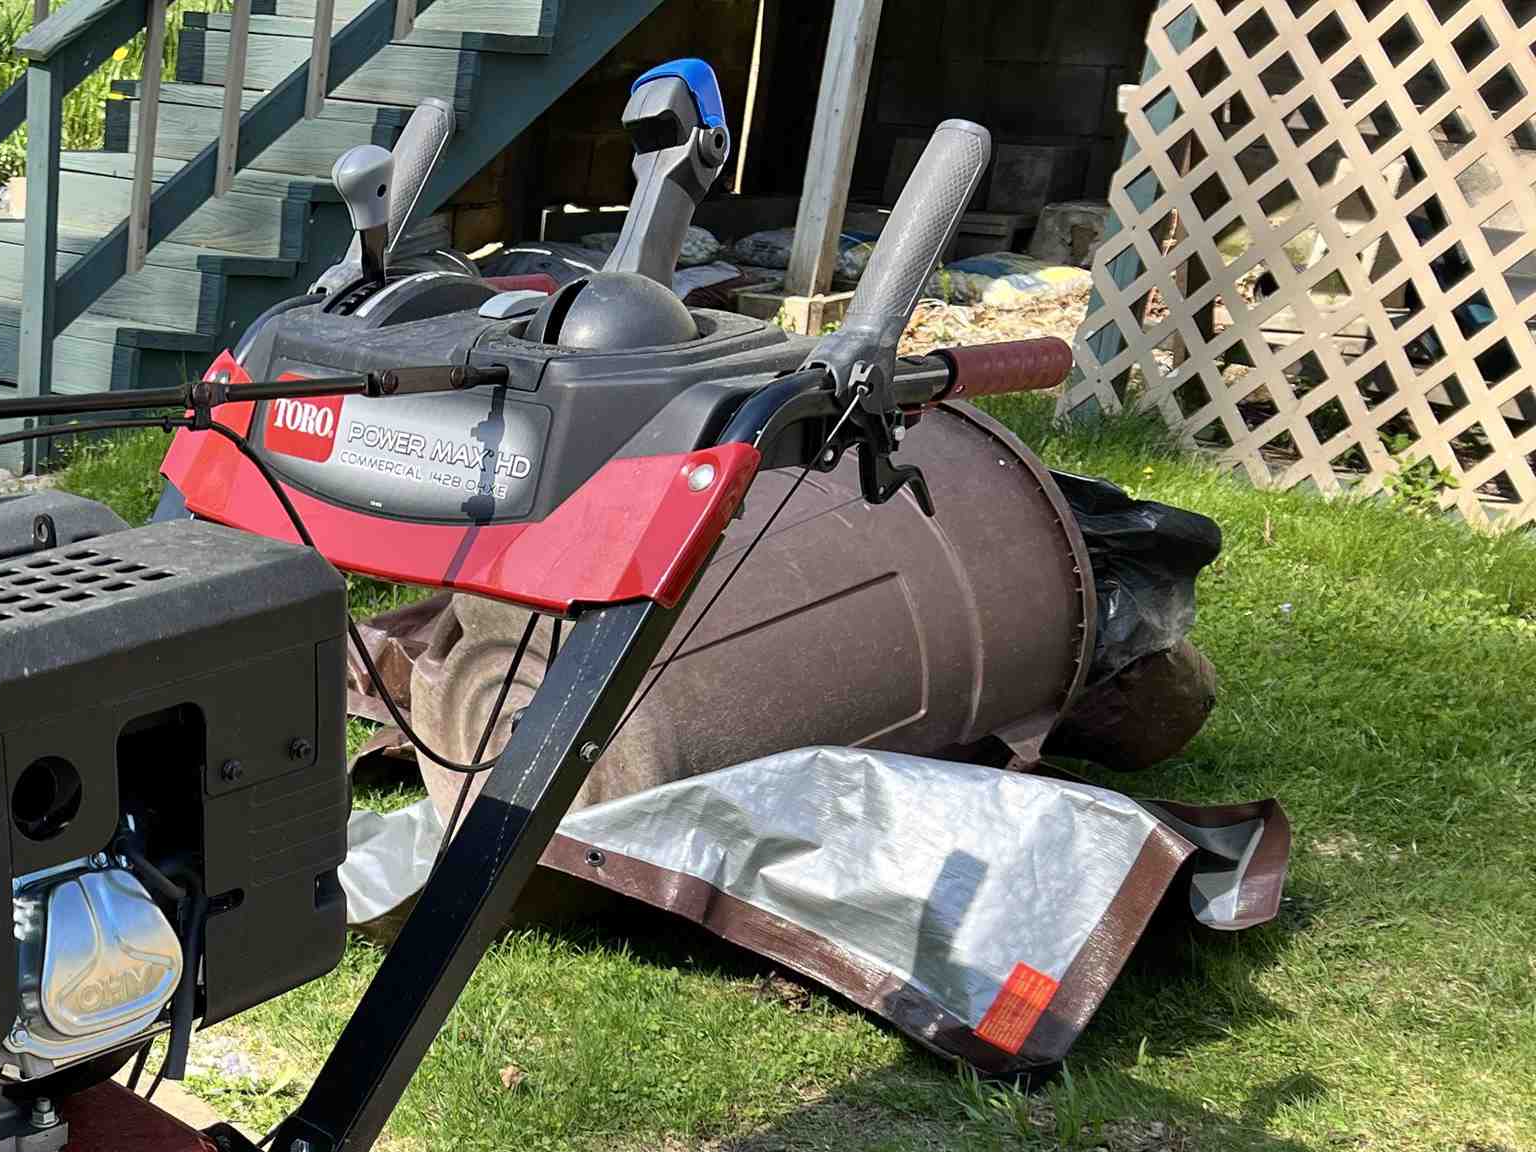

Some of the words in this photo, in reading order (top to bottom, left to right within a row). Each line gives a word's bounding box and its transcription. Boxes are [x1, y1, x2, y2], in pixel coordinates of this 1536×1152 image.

[273, 398, 334, 437] TORO
[340, 450, 422, 480] COMMERCIAL
[430, 472, 462, 488] 1428
[348, 421, 425, 459] POWER
[430, 439, 488, 472] MAX
[495, 452, 531, 479] HD
[80, 966, 149, 1008] OHV
